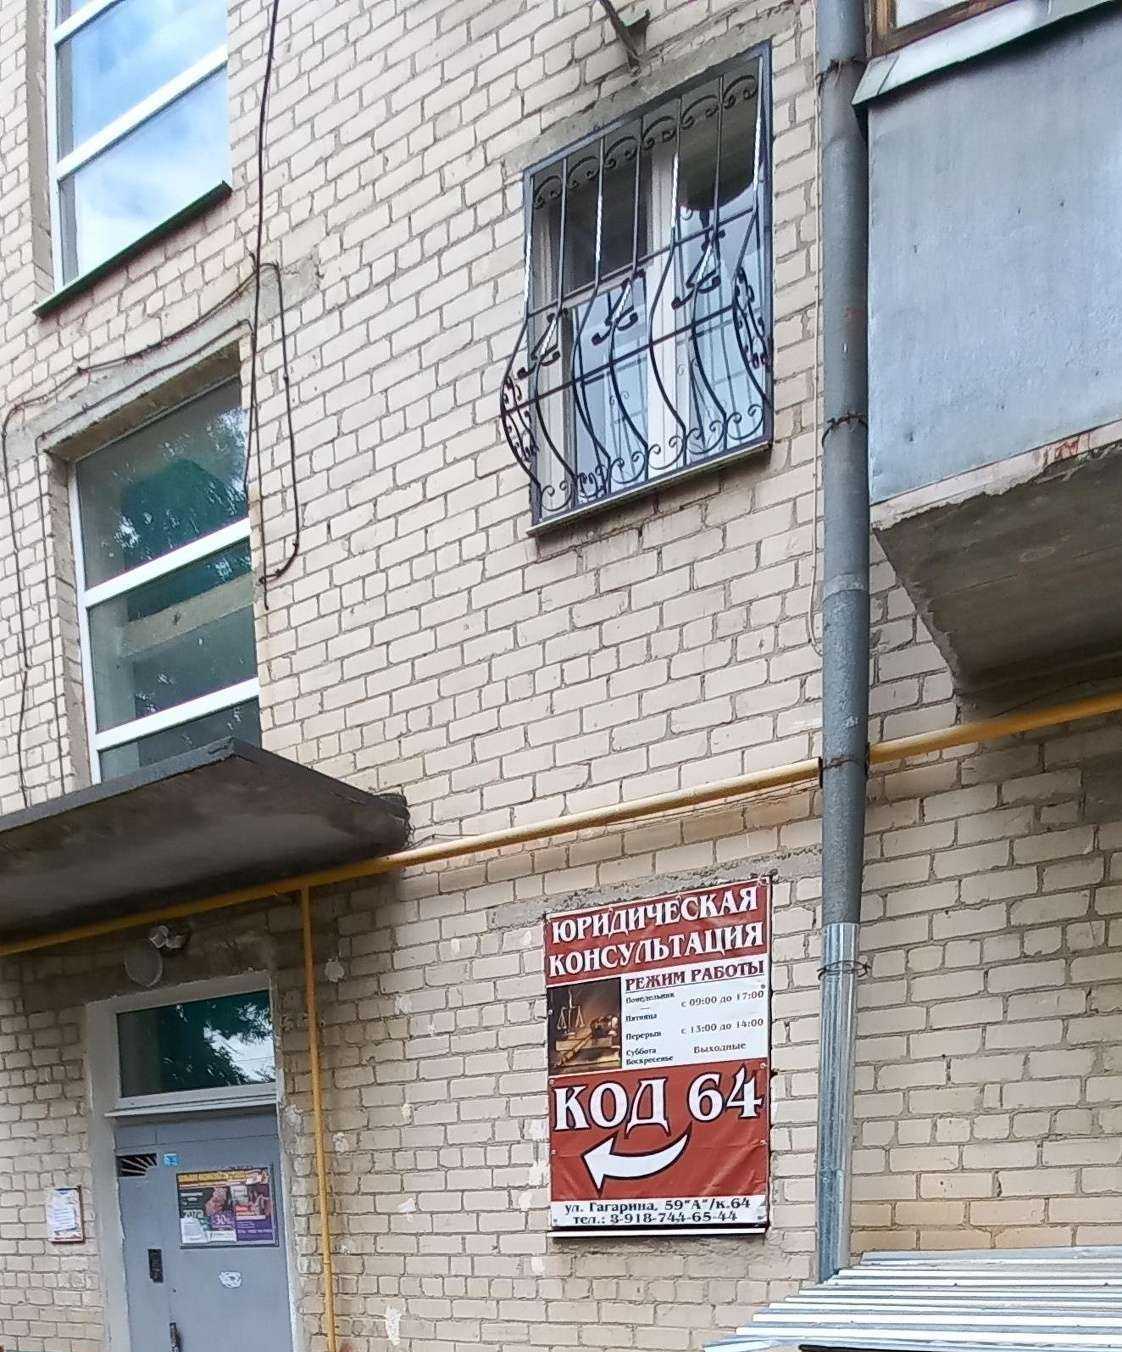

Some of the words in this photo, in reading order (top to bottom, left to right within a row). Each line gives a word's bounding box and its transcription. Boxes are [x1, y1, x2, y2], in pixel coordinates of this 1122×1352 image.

[552, 887, 758, 944] ЮРИДИЧЕСКАЯ
[550, 922, 764, 977] КОНСУЛЬТАЦИЯ
[625, 973, 686, 991] РЕЖИМ
[691, 960, 764, 982] РАБОТЫ
[689, 996, 718, 1007] 09:00
[720, 995, 733, 1005] до
[736, 990, 764, 1001] 17:00
[720, 1023, 733, 1032] до
[736, 1018, 764, 1029] 14:00
[626, 1048, 657, 1057] Суббота
[553, 1077, 671, 1139] КОД
[687, 1064, 763, 1122] 64
[565, 1204, 584, 1214] ул.
[573, 1214, 606, 1225] тел.:
